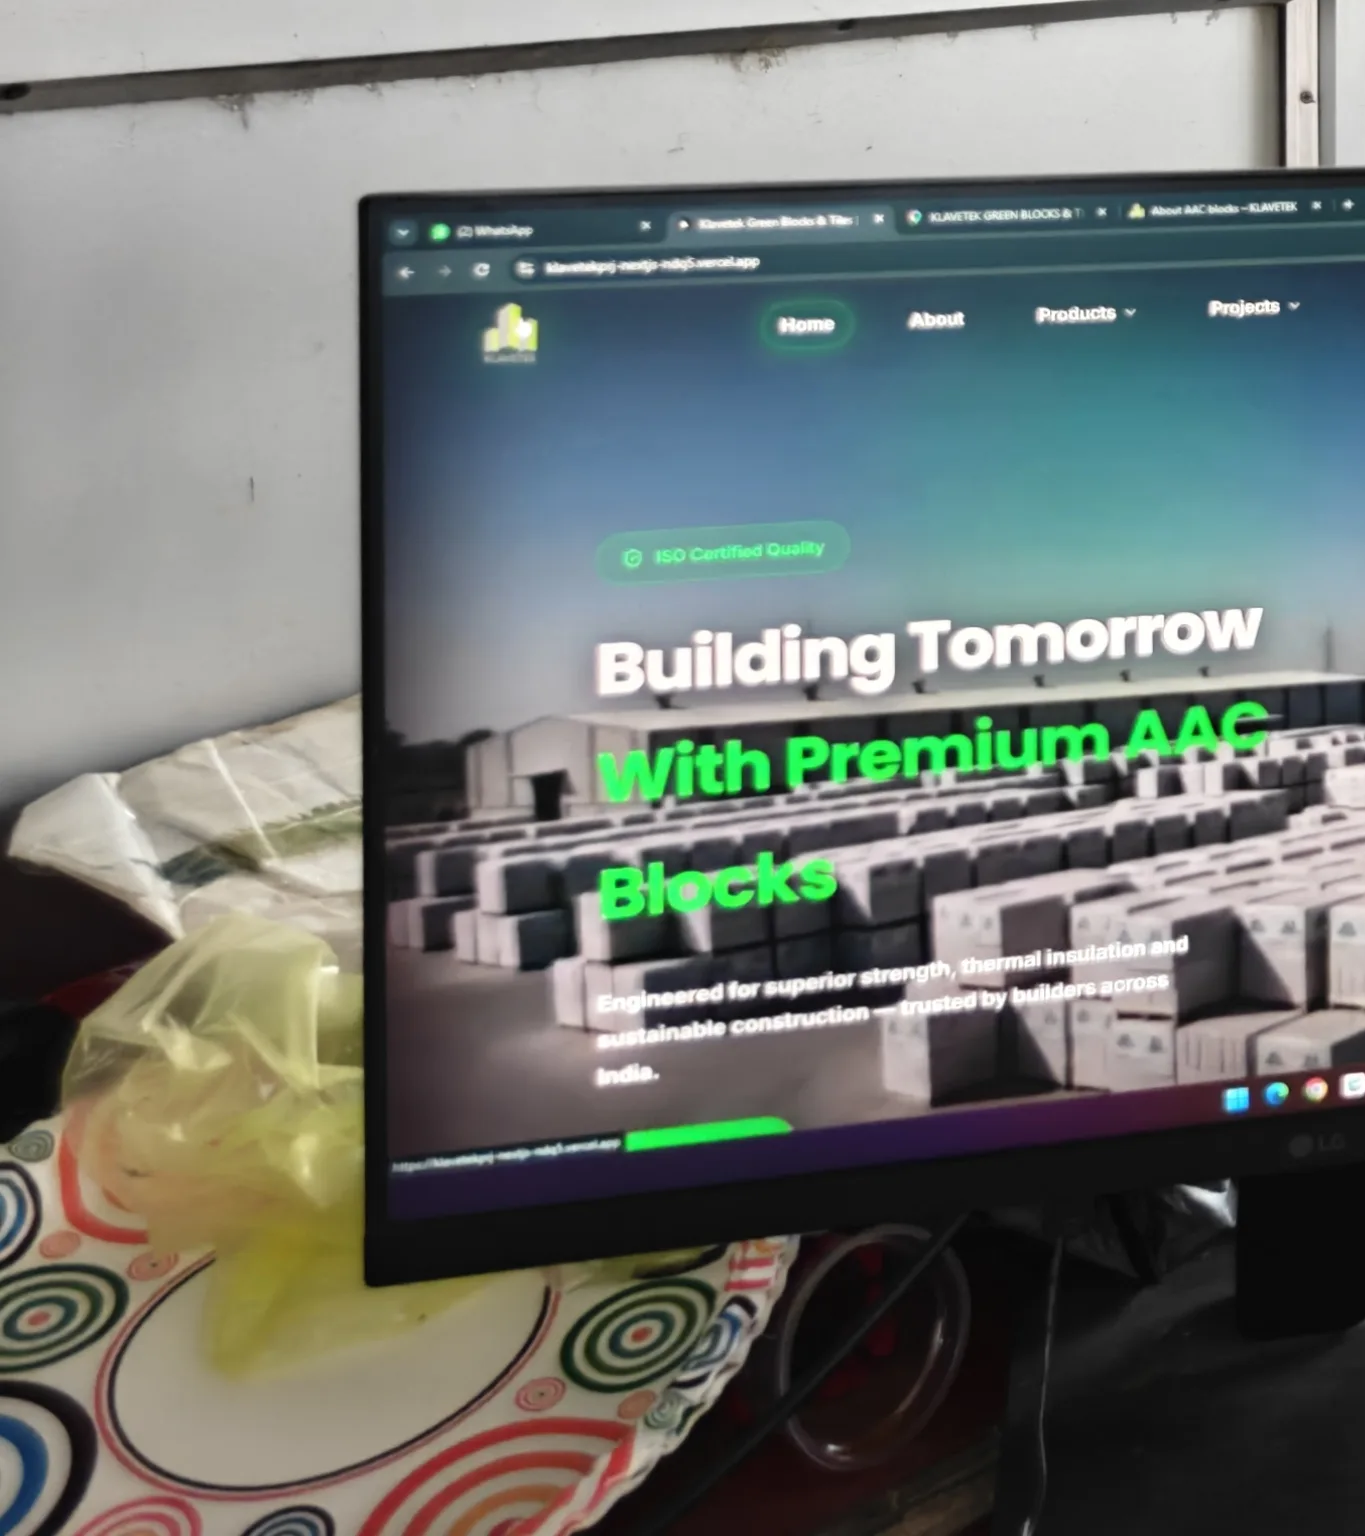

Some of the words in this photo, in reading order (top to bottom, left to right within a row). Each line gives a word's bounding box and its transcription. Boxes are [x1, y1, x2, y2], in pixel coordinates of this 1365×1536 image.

[930, 210, 982, 223] KLAVETEK
[984, 209, 1019, 222] GREEN
[1020, 208, 1061, 221] BLOCKS
[1151, 205, 1182, 217] About
[1185, 204, 1205, 215] AAC
[1248, 201, 1298, 214] KLAVETEK
[475, 224, 534, 241] WhatsApp
[747, 217, 779, 229] Green
[780, 215, 815, 228] Blocks
[1035, 306, 1117, 325] Products
[1208, 299, 1280, 319] Projects
[776, 315, 836, 337] Home
[908, 310, 966, 330] About
[655, 548, 686, 565] ISO
[690, 543, 762, 563] Certified
[766, 539, 825, 558] Quality
[595, 623, 895, 696] Building
[906, 607, 1263, 673] Tomorrow
[597, 739, 771, 802] With
[786, 715, 1110, 789] Premium
[1123, 700, 1269, 759] AAC
[599, 851, 837, 921] Blocks
[596, 983, 724, 1014] Engineered
[726, 980, 761, 1001] for
[763, 971, 856, 999] superior
[860, 959, 957, 986] strength,
[960, 950, 1042, 975] thermal
[1047, 940, 1146, 966] insulation
[1149, 934, 1189, 956] and
[595, 1020, 727, 1049] sustainable
[729, 1005, 870, 1035] construction
[900, 991, 977, 1015] trusted
[982, 988, 1007, 1010] by
[1011, 981, 1096, 1004] builders
[1101, 973, 1169, 994] across
[594, 1063, 660, 1087] India.
[1318, 1133, 1346, 1151] LG
